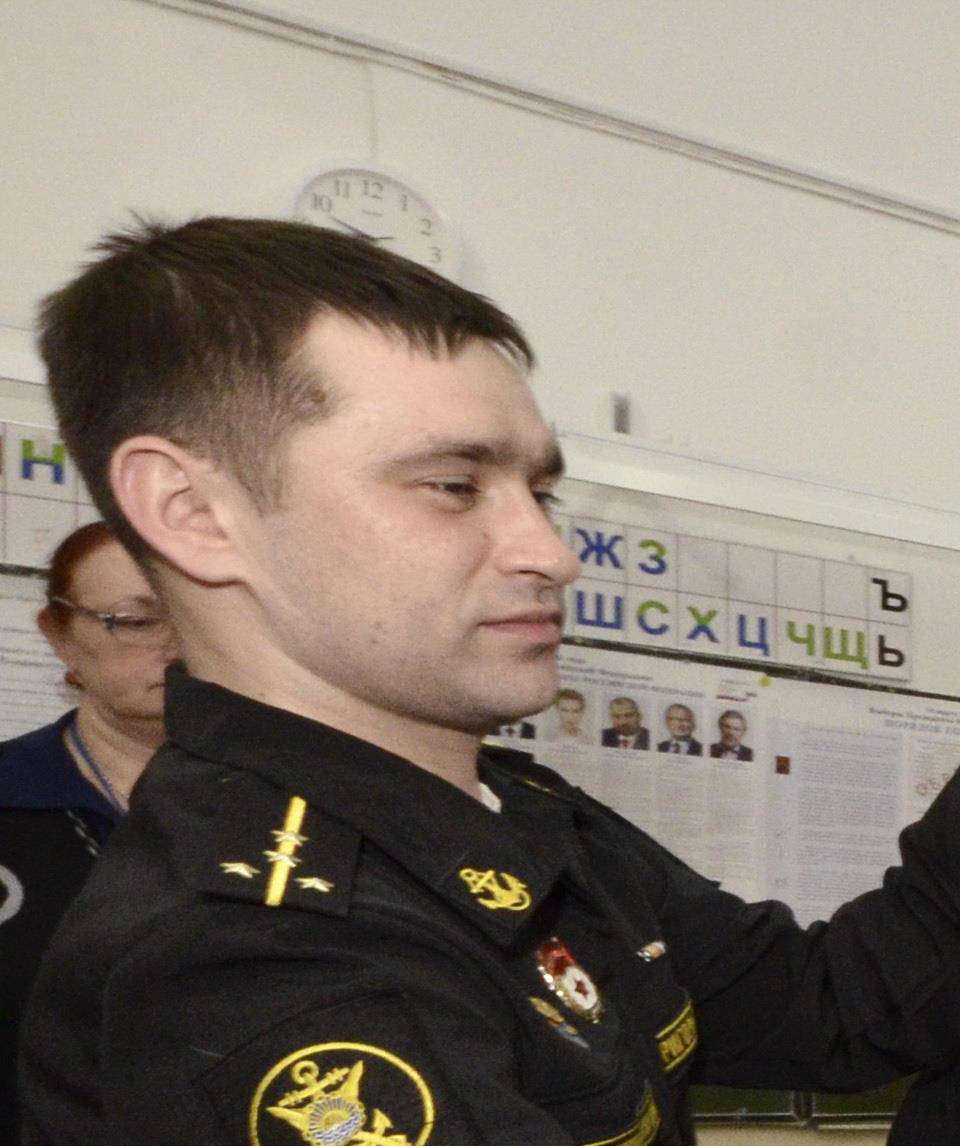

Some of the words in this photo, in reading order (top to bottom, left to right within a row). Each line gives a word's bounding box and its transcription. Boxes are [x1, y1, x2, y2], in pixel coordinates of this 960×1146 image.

[334, 179, 350, 199] 11
[362, 179, 384, 200] 12
[311, 193, 333, 212] 10
[401, 193, 408, 211] 1
[418, 217, 433, 236] 2
[427, 246, 442, 263] 3
[22, 439, 65, 485] Н
[576, 528, 624, 569] Ж
[638, 539, 668, 575] З
[872, 577, 909, 612] Ъ
[577, 591, 624, 630] Ш
[637, 600, 670, 635] С
[687, 605, 720, 644] Х
[738, 614, 770, 657] Ц
[878, 634, 905, 668] Ь
